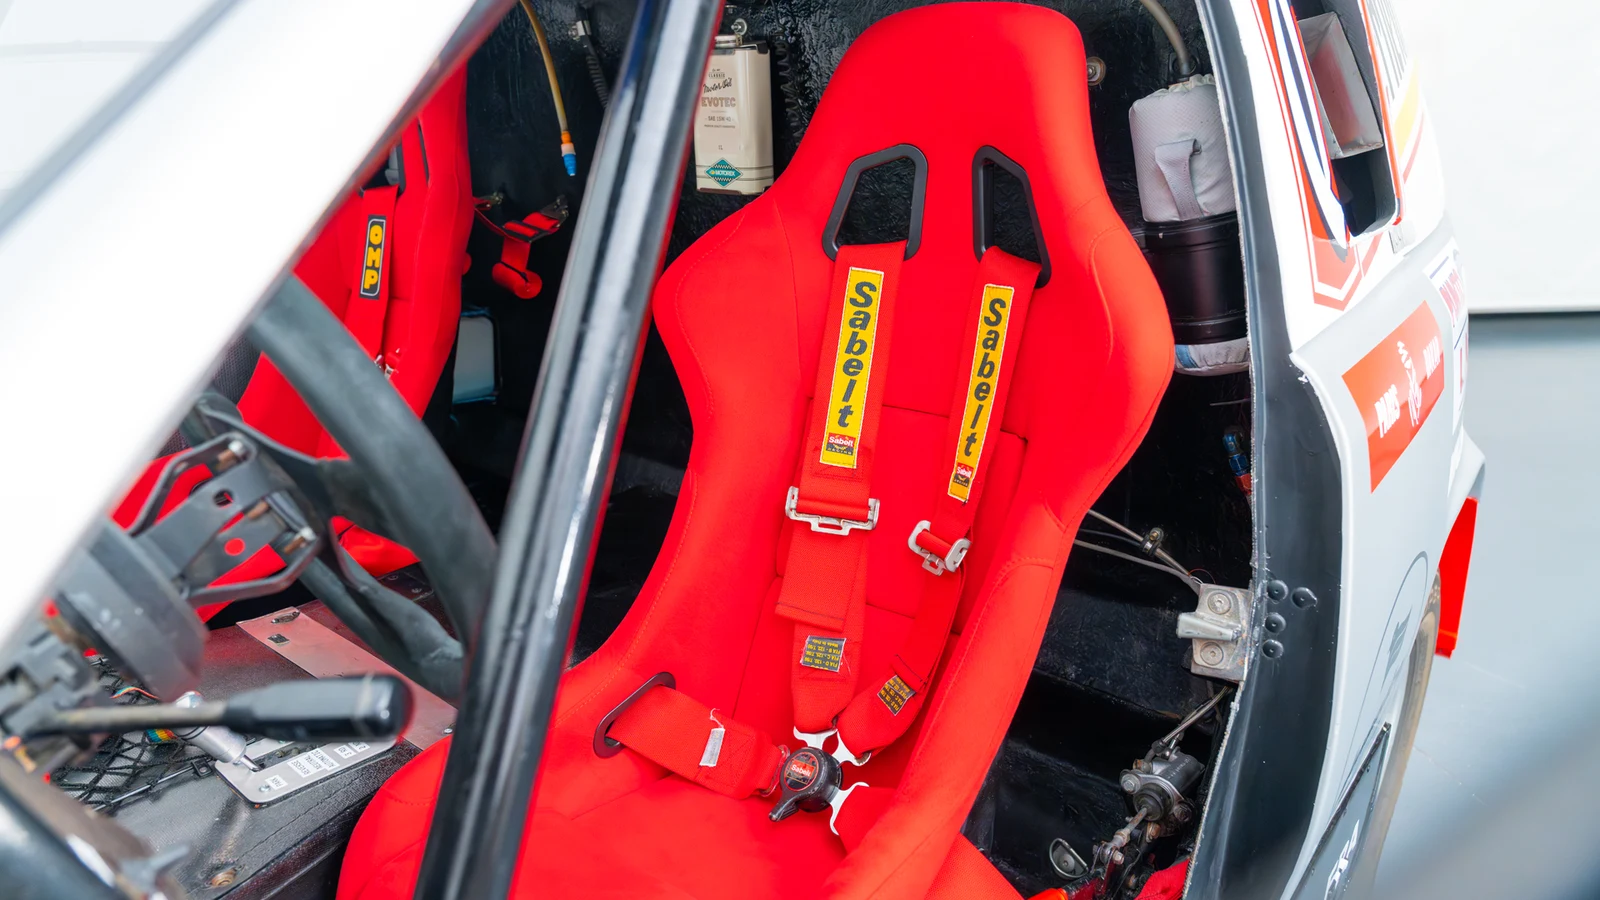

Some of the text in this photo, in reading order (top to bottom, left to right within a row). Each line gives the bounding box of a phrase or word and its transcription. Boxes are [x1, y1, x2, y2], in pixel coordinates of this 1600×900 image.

[701, 97, 736, 107] EVOTEC
[364, 224, 383, 290] OMP
[838, 281, 877, 428] Sabelt
[964, 298, 1006, 457] Sabelt
[829, 436, 854, 447] Sabelt
[305, 755, 322, 770] NEUTRAL
[311, 750, 334, 768] AUTOMATIC
[291, 760, 310, 775] REVERSE
[791, 764, 811, 777] Sabelt
[272, 777, 282, 787] PARK
